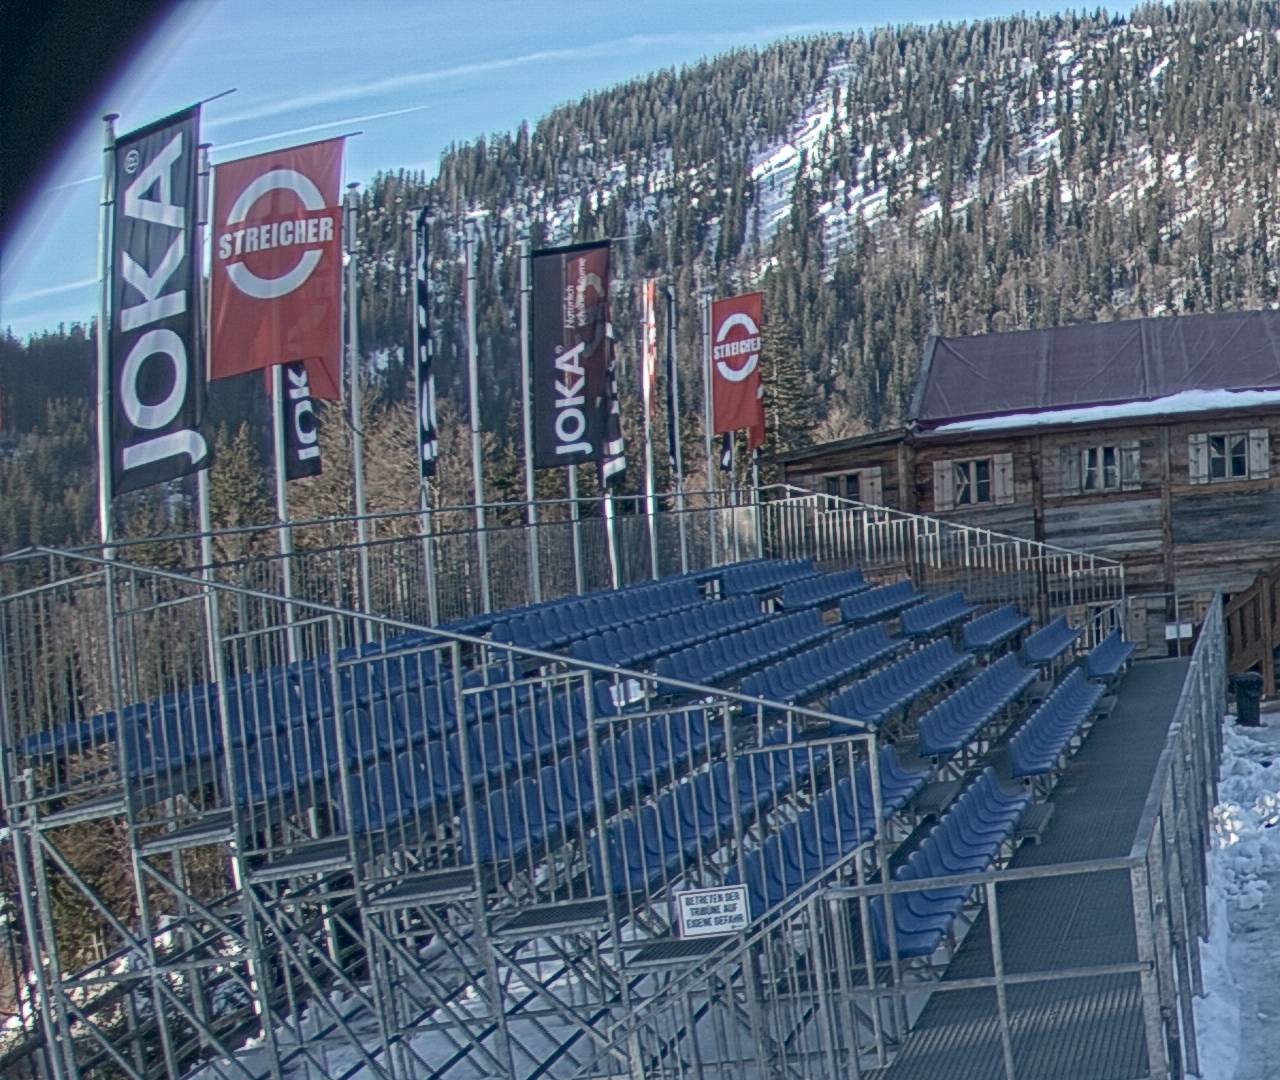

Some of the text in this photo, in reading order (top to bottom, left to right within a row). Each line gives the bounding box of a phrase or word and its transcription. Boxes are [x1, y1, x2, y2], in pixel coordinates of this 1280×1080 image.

[218, 216, 335, 260] STREICHER
[120, 131, 208, 470] JOKA
[555, 342, 593, 455] JOKA
